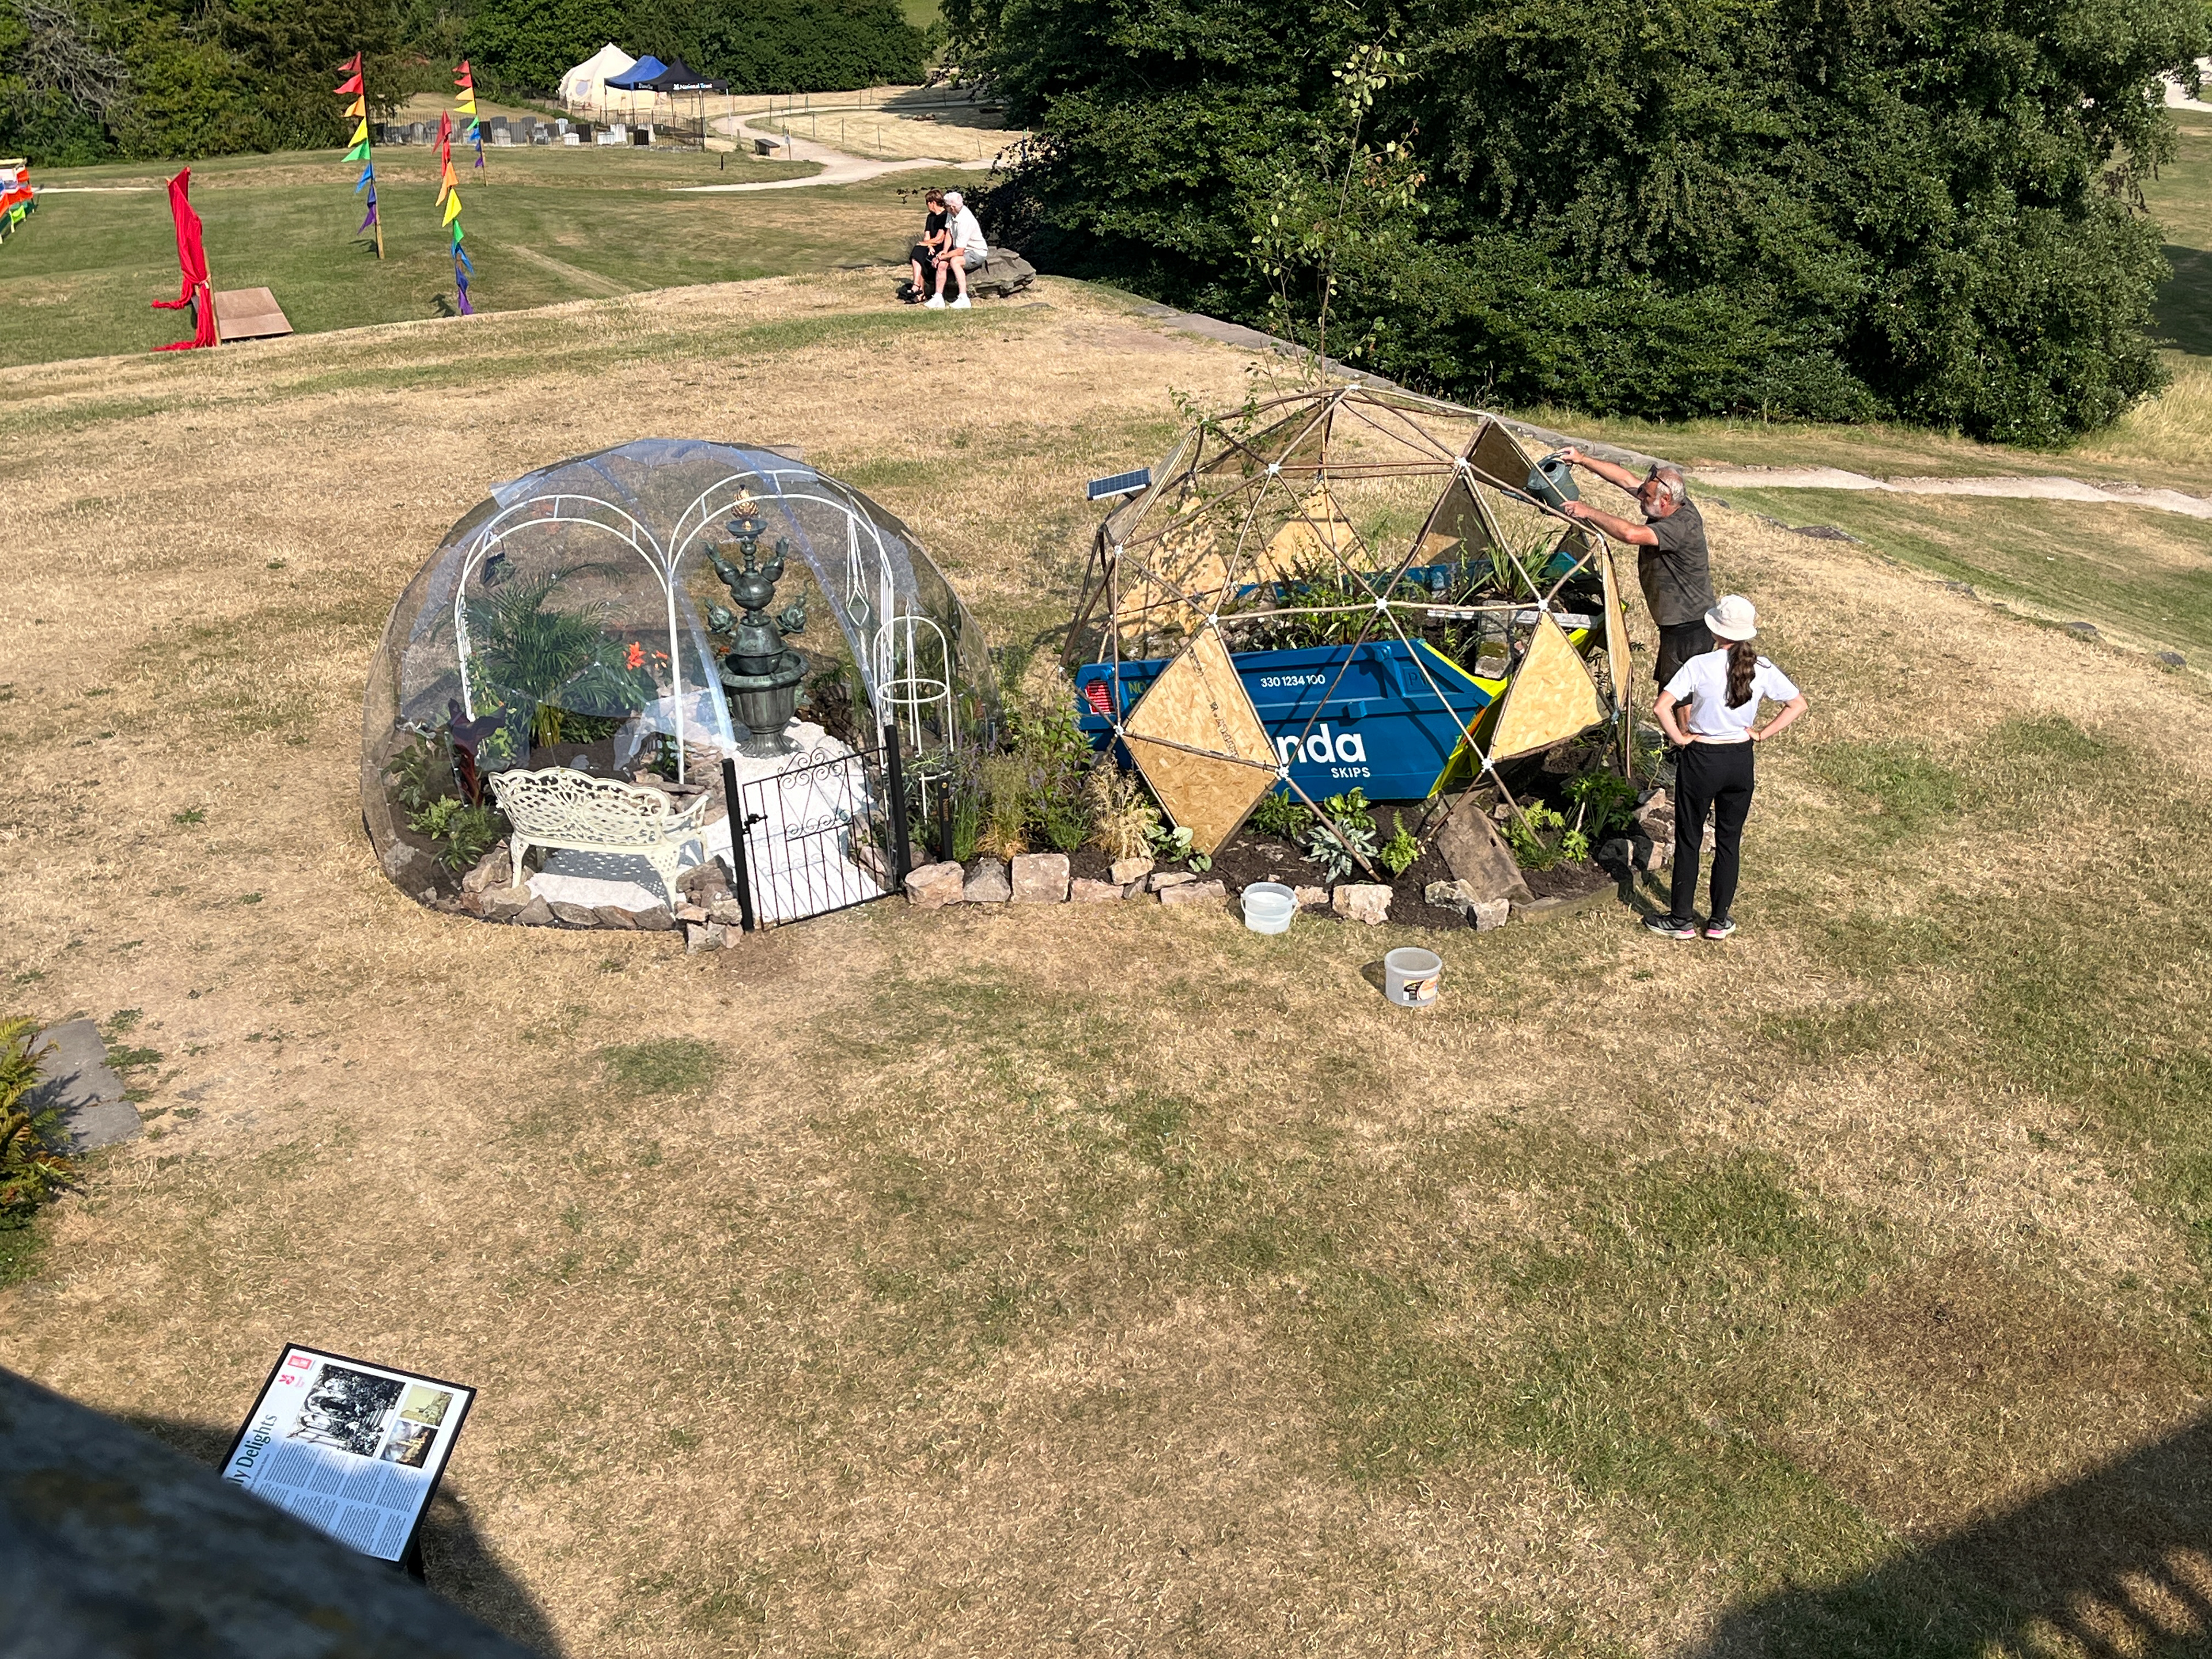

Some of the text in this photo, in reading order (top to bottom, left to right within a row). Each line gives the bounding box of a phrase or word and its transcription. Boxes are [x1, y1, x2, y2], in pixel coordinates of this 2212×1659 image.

[1260, 674, 1325, 687] 330 1234 100
[1276, 723, 1367, 764] nda
[1331, 767, 1371, 778] SKIPS
[235, 1414, 277, 1468] Delights
